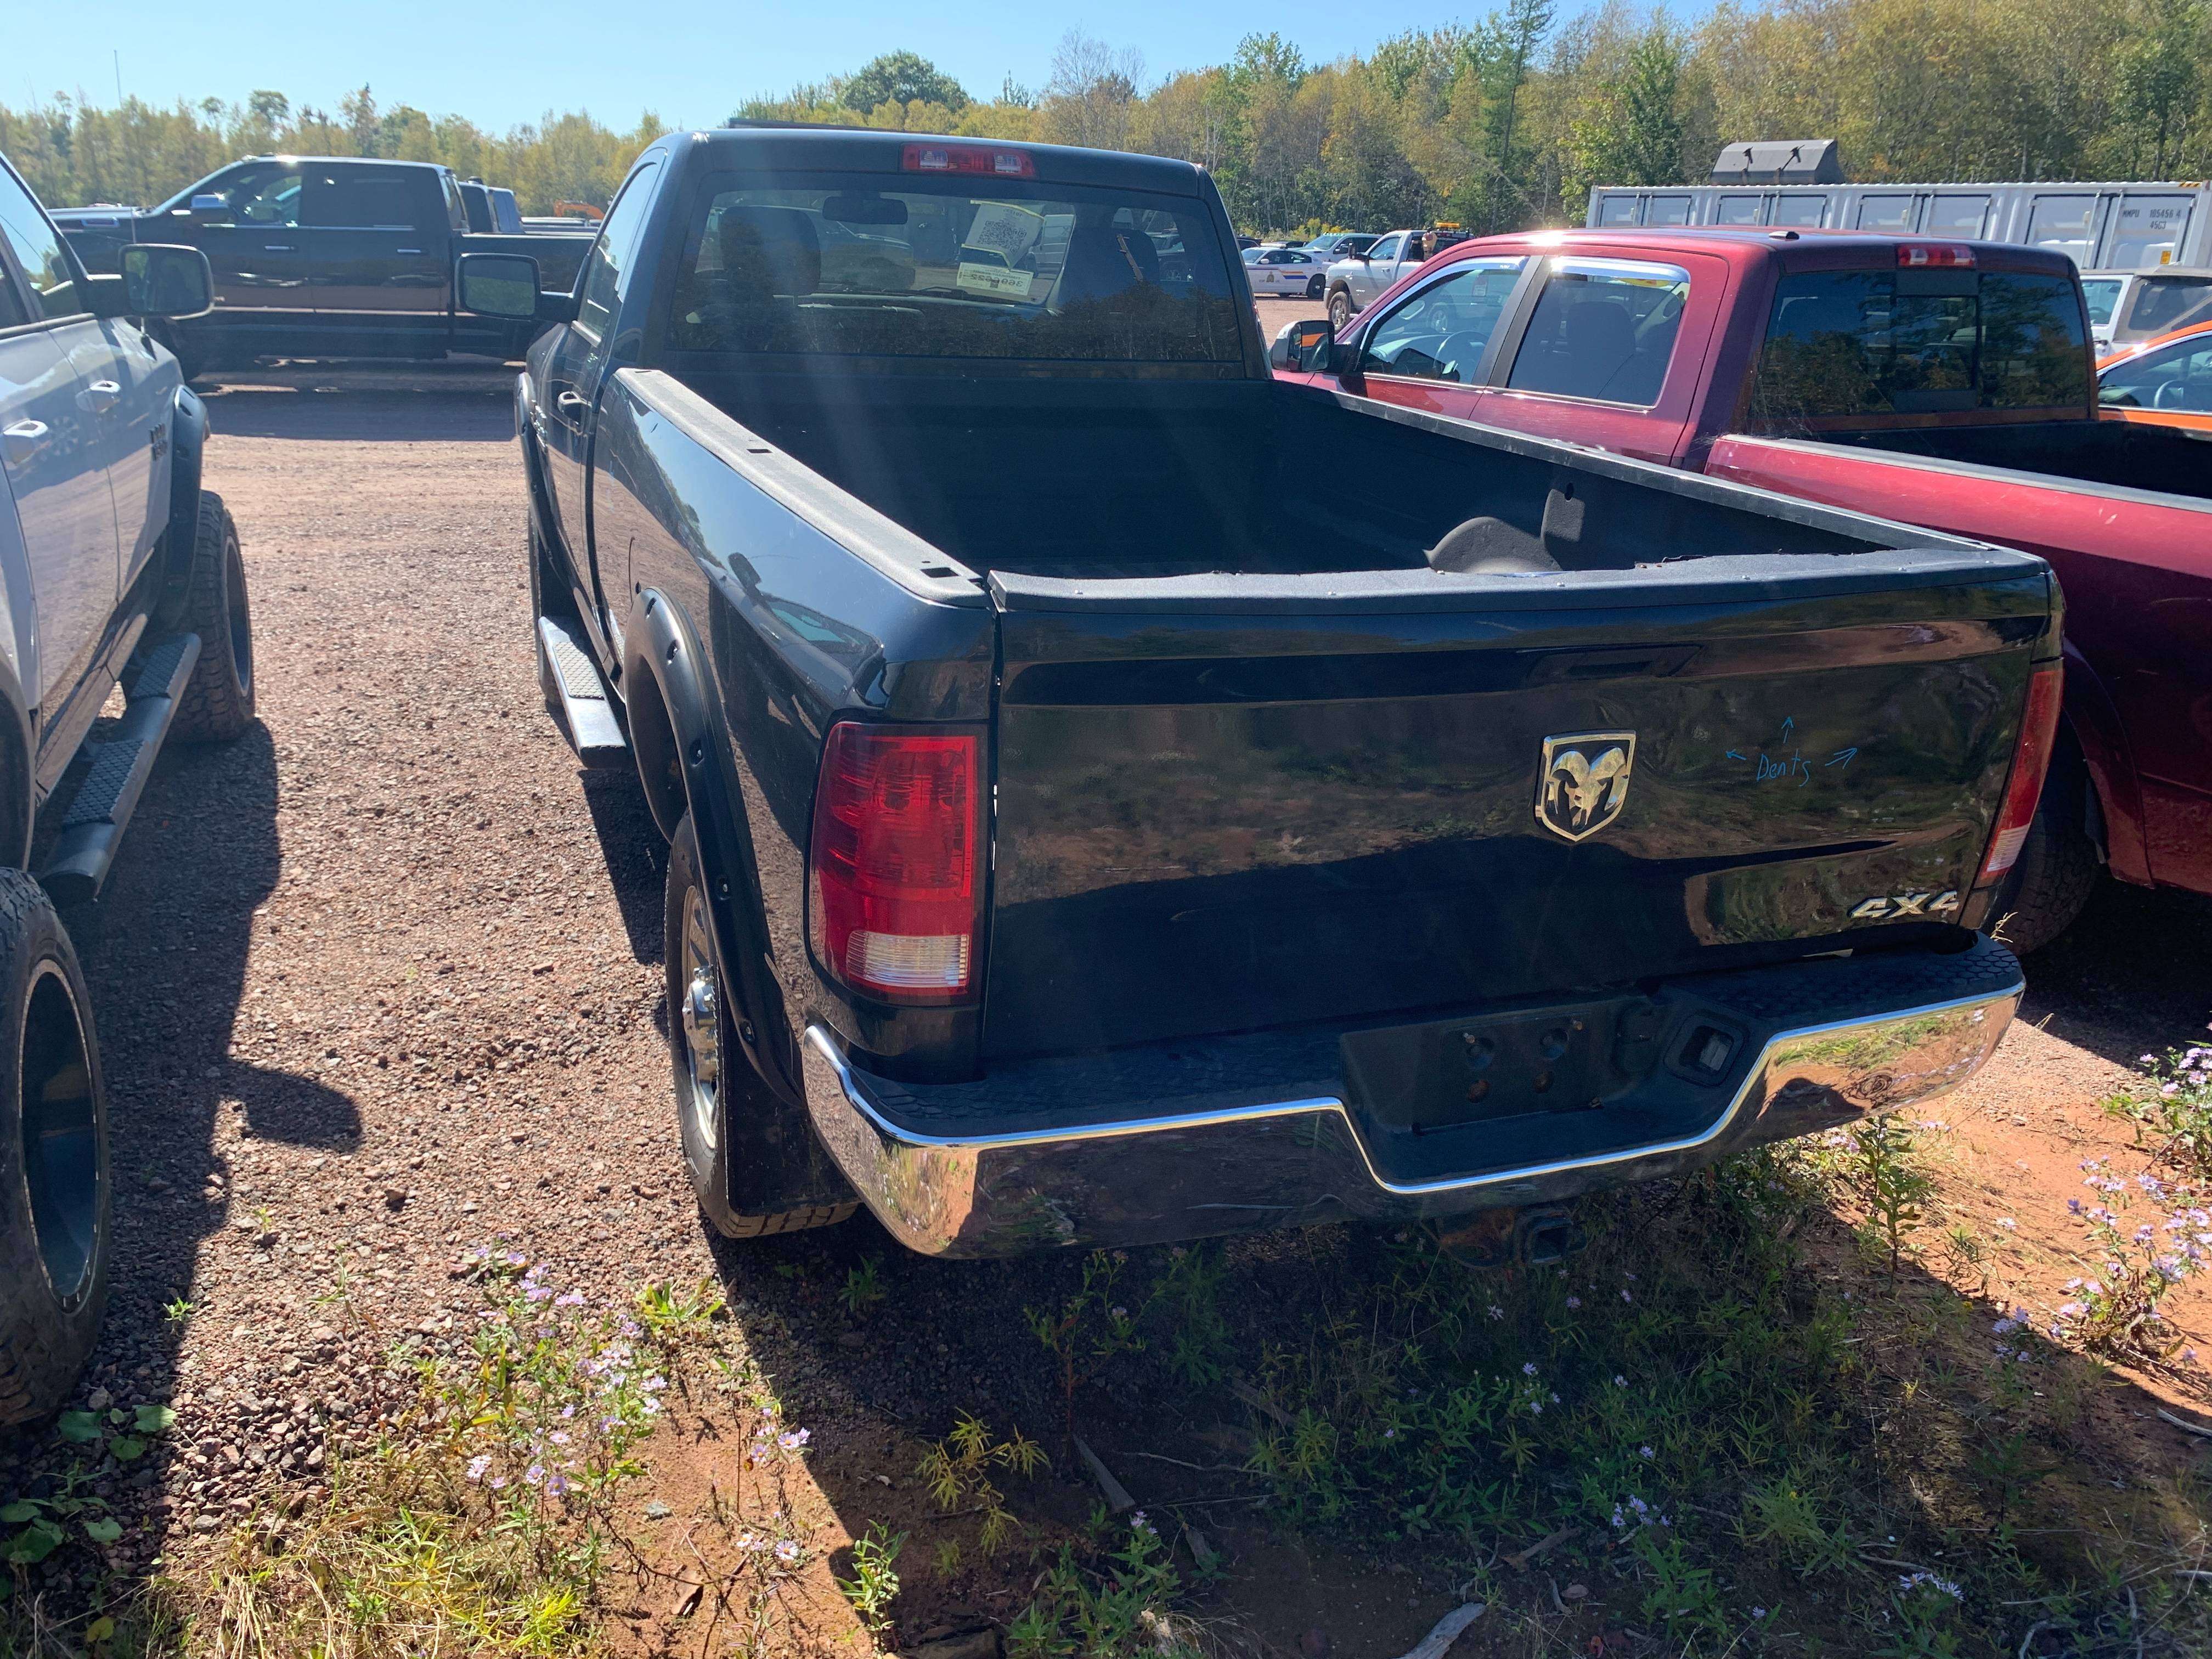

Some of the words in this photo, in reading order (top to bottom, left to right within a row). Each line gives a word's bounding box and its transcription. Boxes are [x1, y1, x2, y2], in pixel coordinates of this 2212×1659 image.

[2122, 209, 2140, 218] MMPU
[2176, 208, 2181, 218] 4
[1757, 748, 1812, 787] Dents
